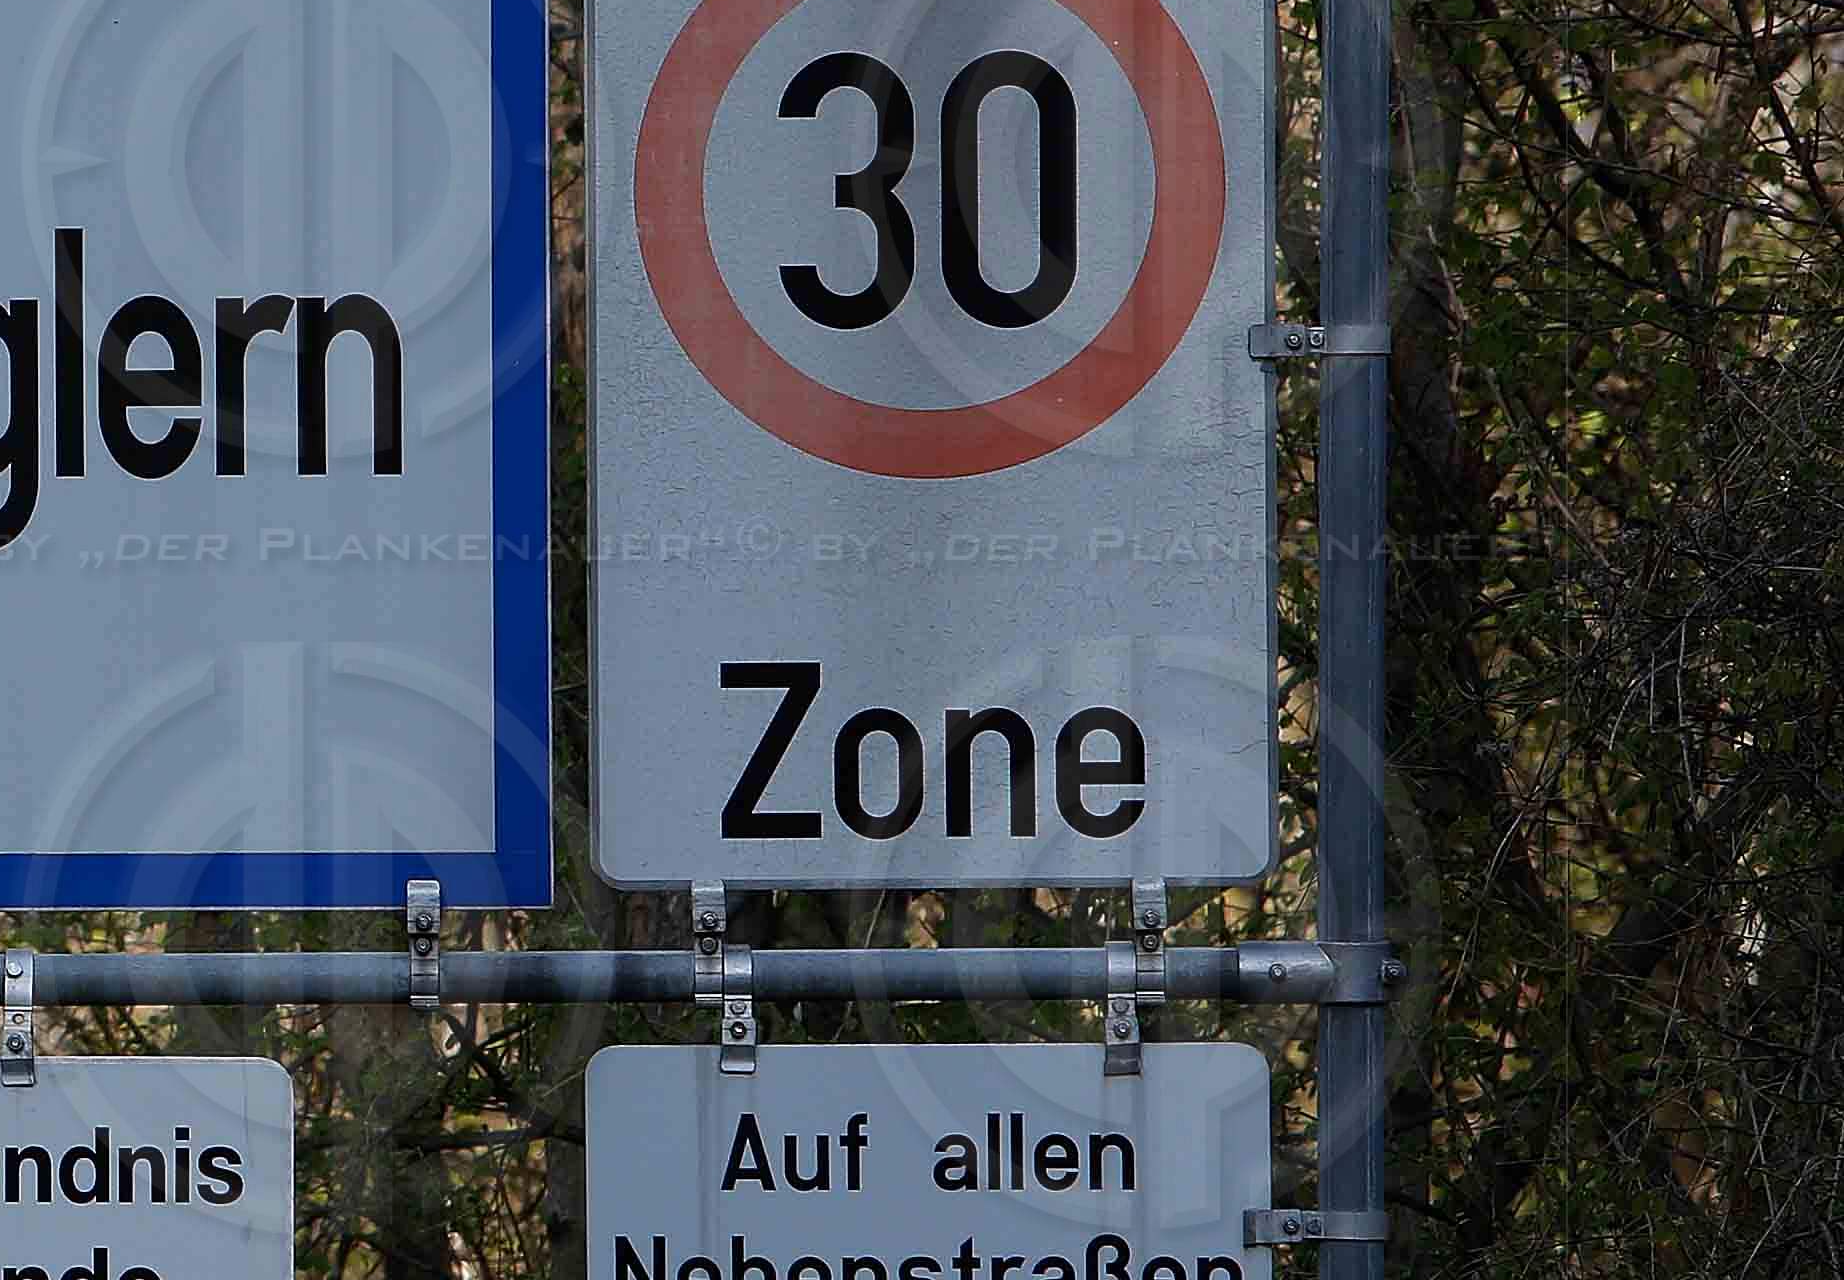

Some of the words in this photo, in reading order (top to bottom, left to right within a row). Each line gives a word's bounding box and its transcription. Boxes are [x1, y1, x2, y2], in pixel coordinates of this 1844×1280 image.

[778, 50, 1077, 330] 30
[720, 662, 1146, 840] Zone
[720, 1113, 868, 1192] Auf
[933, 1112, 1135, 1191] allen
